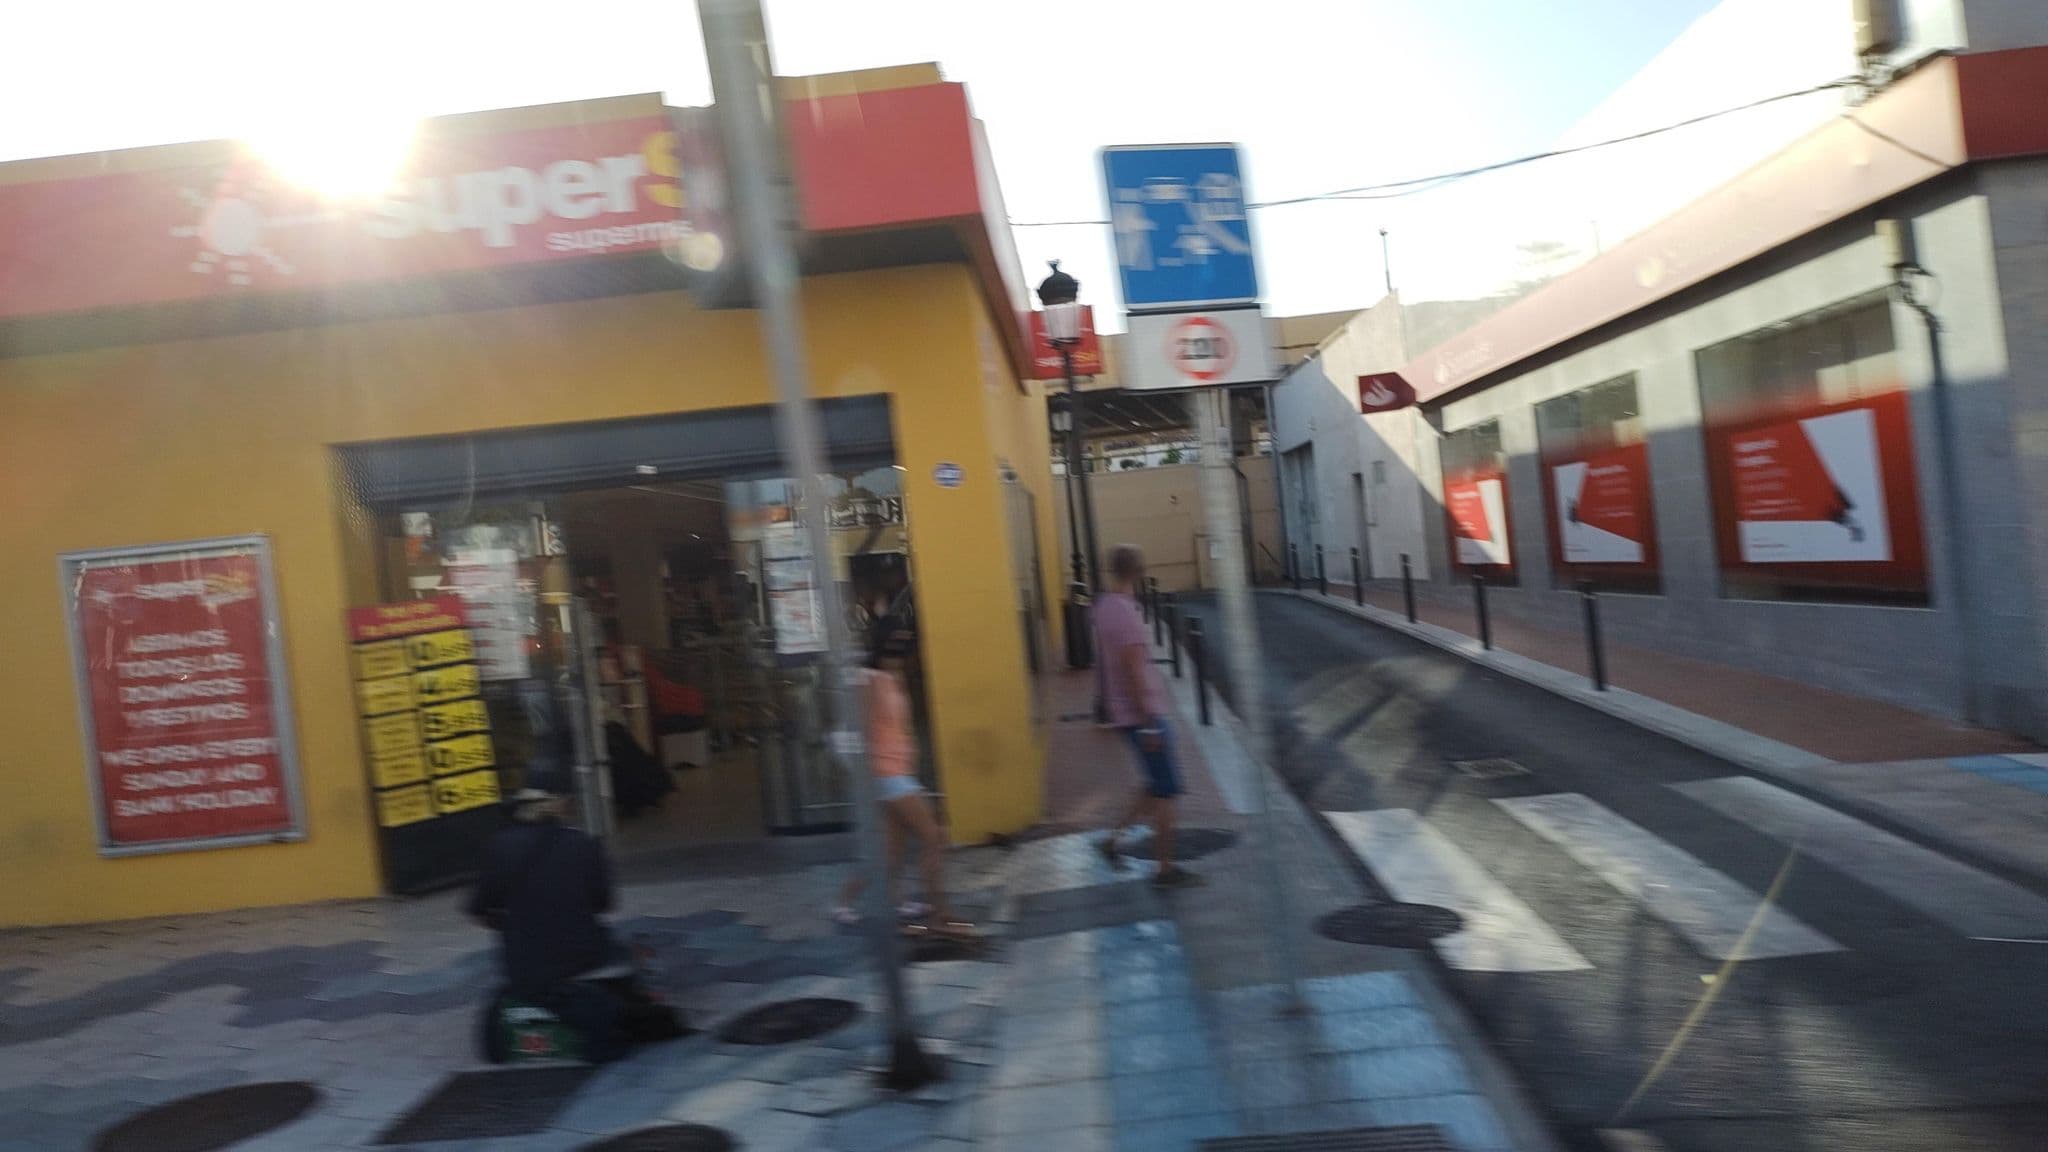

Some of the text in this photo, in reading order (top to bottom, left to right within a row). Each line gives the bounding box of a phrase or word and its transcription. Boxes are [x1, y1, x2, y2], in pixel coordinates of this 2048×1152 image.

[120, 768, 207, 792] SUNDAY
[114, 786, 278, 817] BANK HOLIDAY
